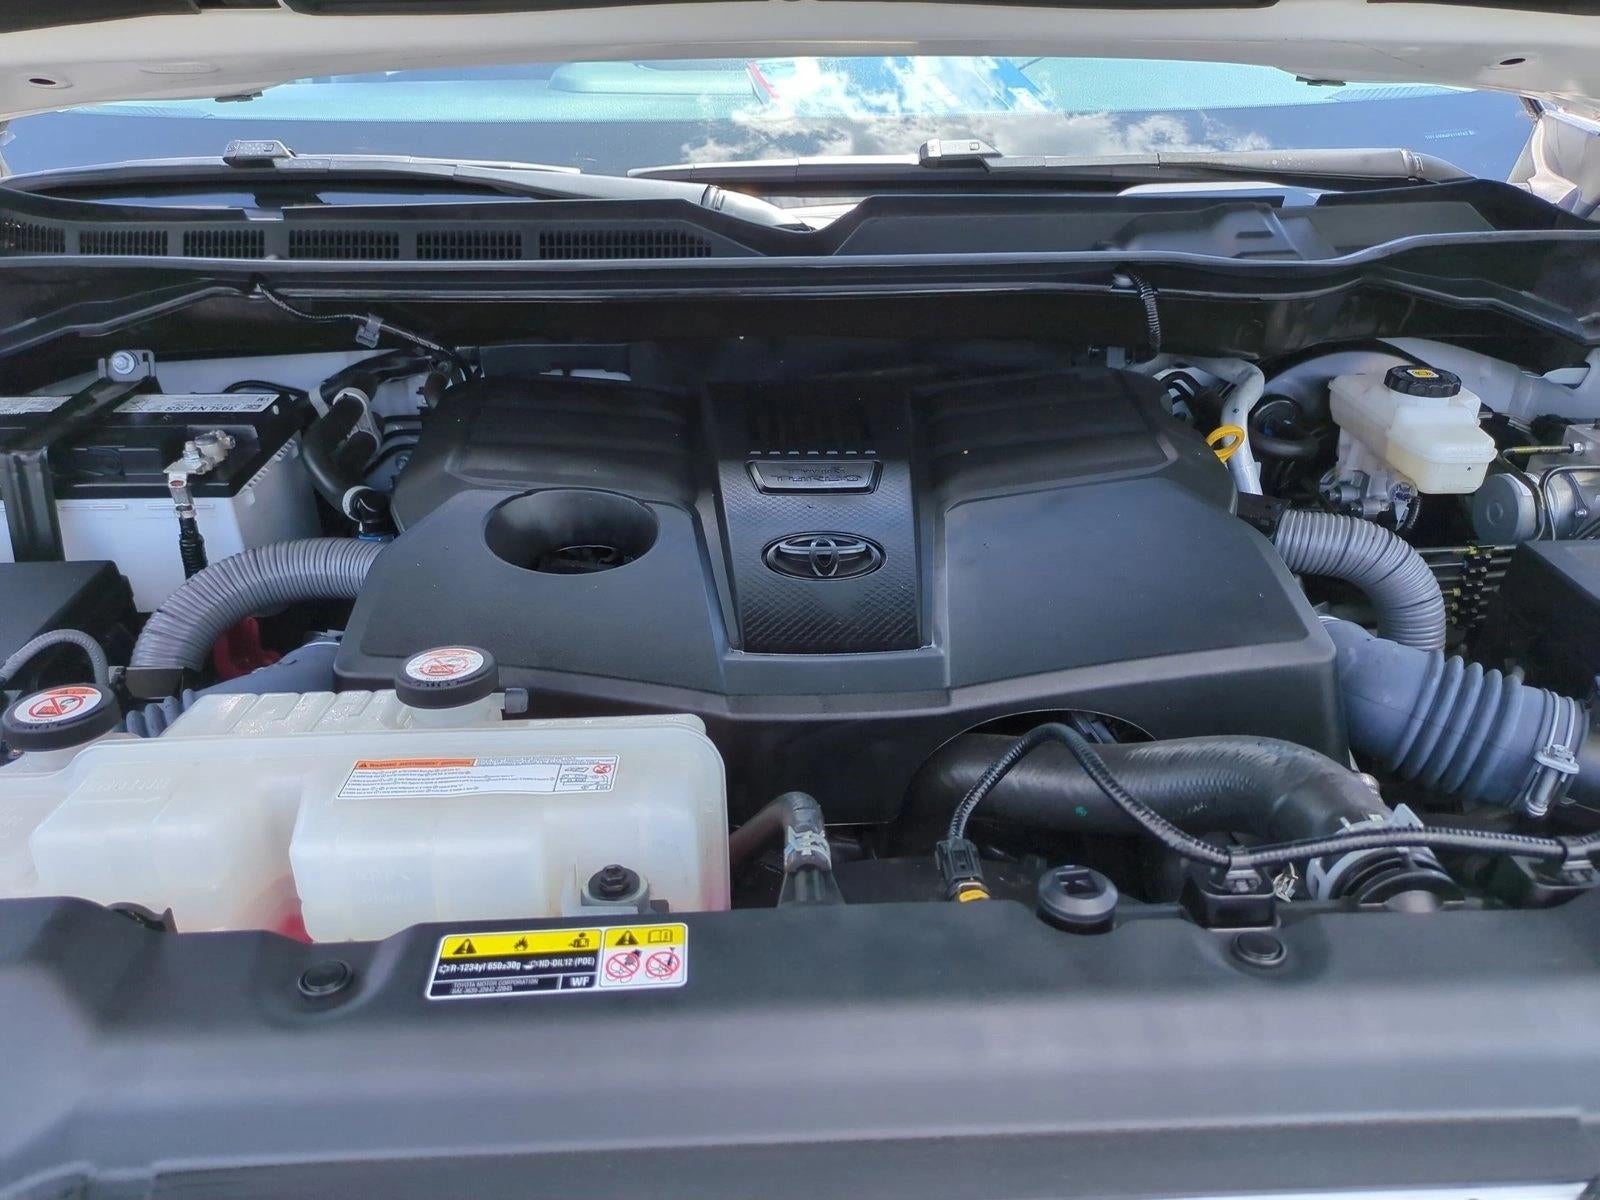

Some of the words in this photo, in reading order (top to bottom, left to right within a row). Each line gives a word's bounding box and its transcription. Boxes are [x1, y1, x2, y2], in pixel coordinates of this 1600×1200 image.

[770, 474, 862, 482] TURBO
[450, 963, 486, 973] R-1234yf
[571, 977, 590, 987] WF
